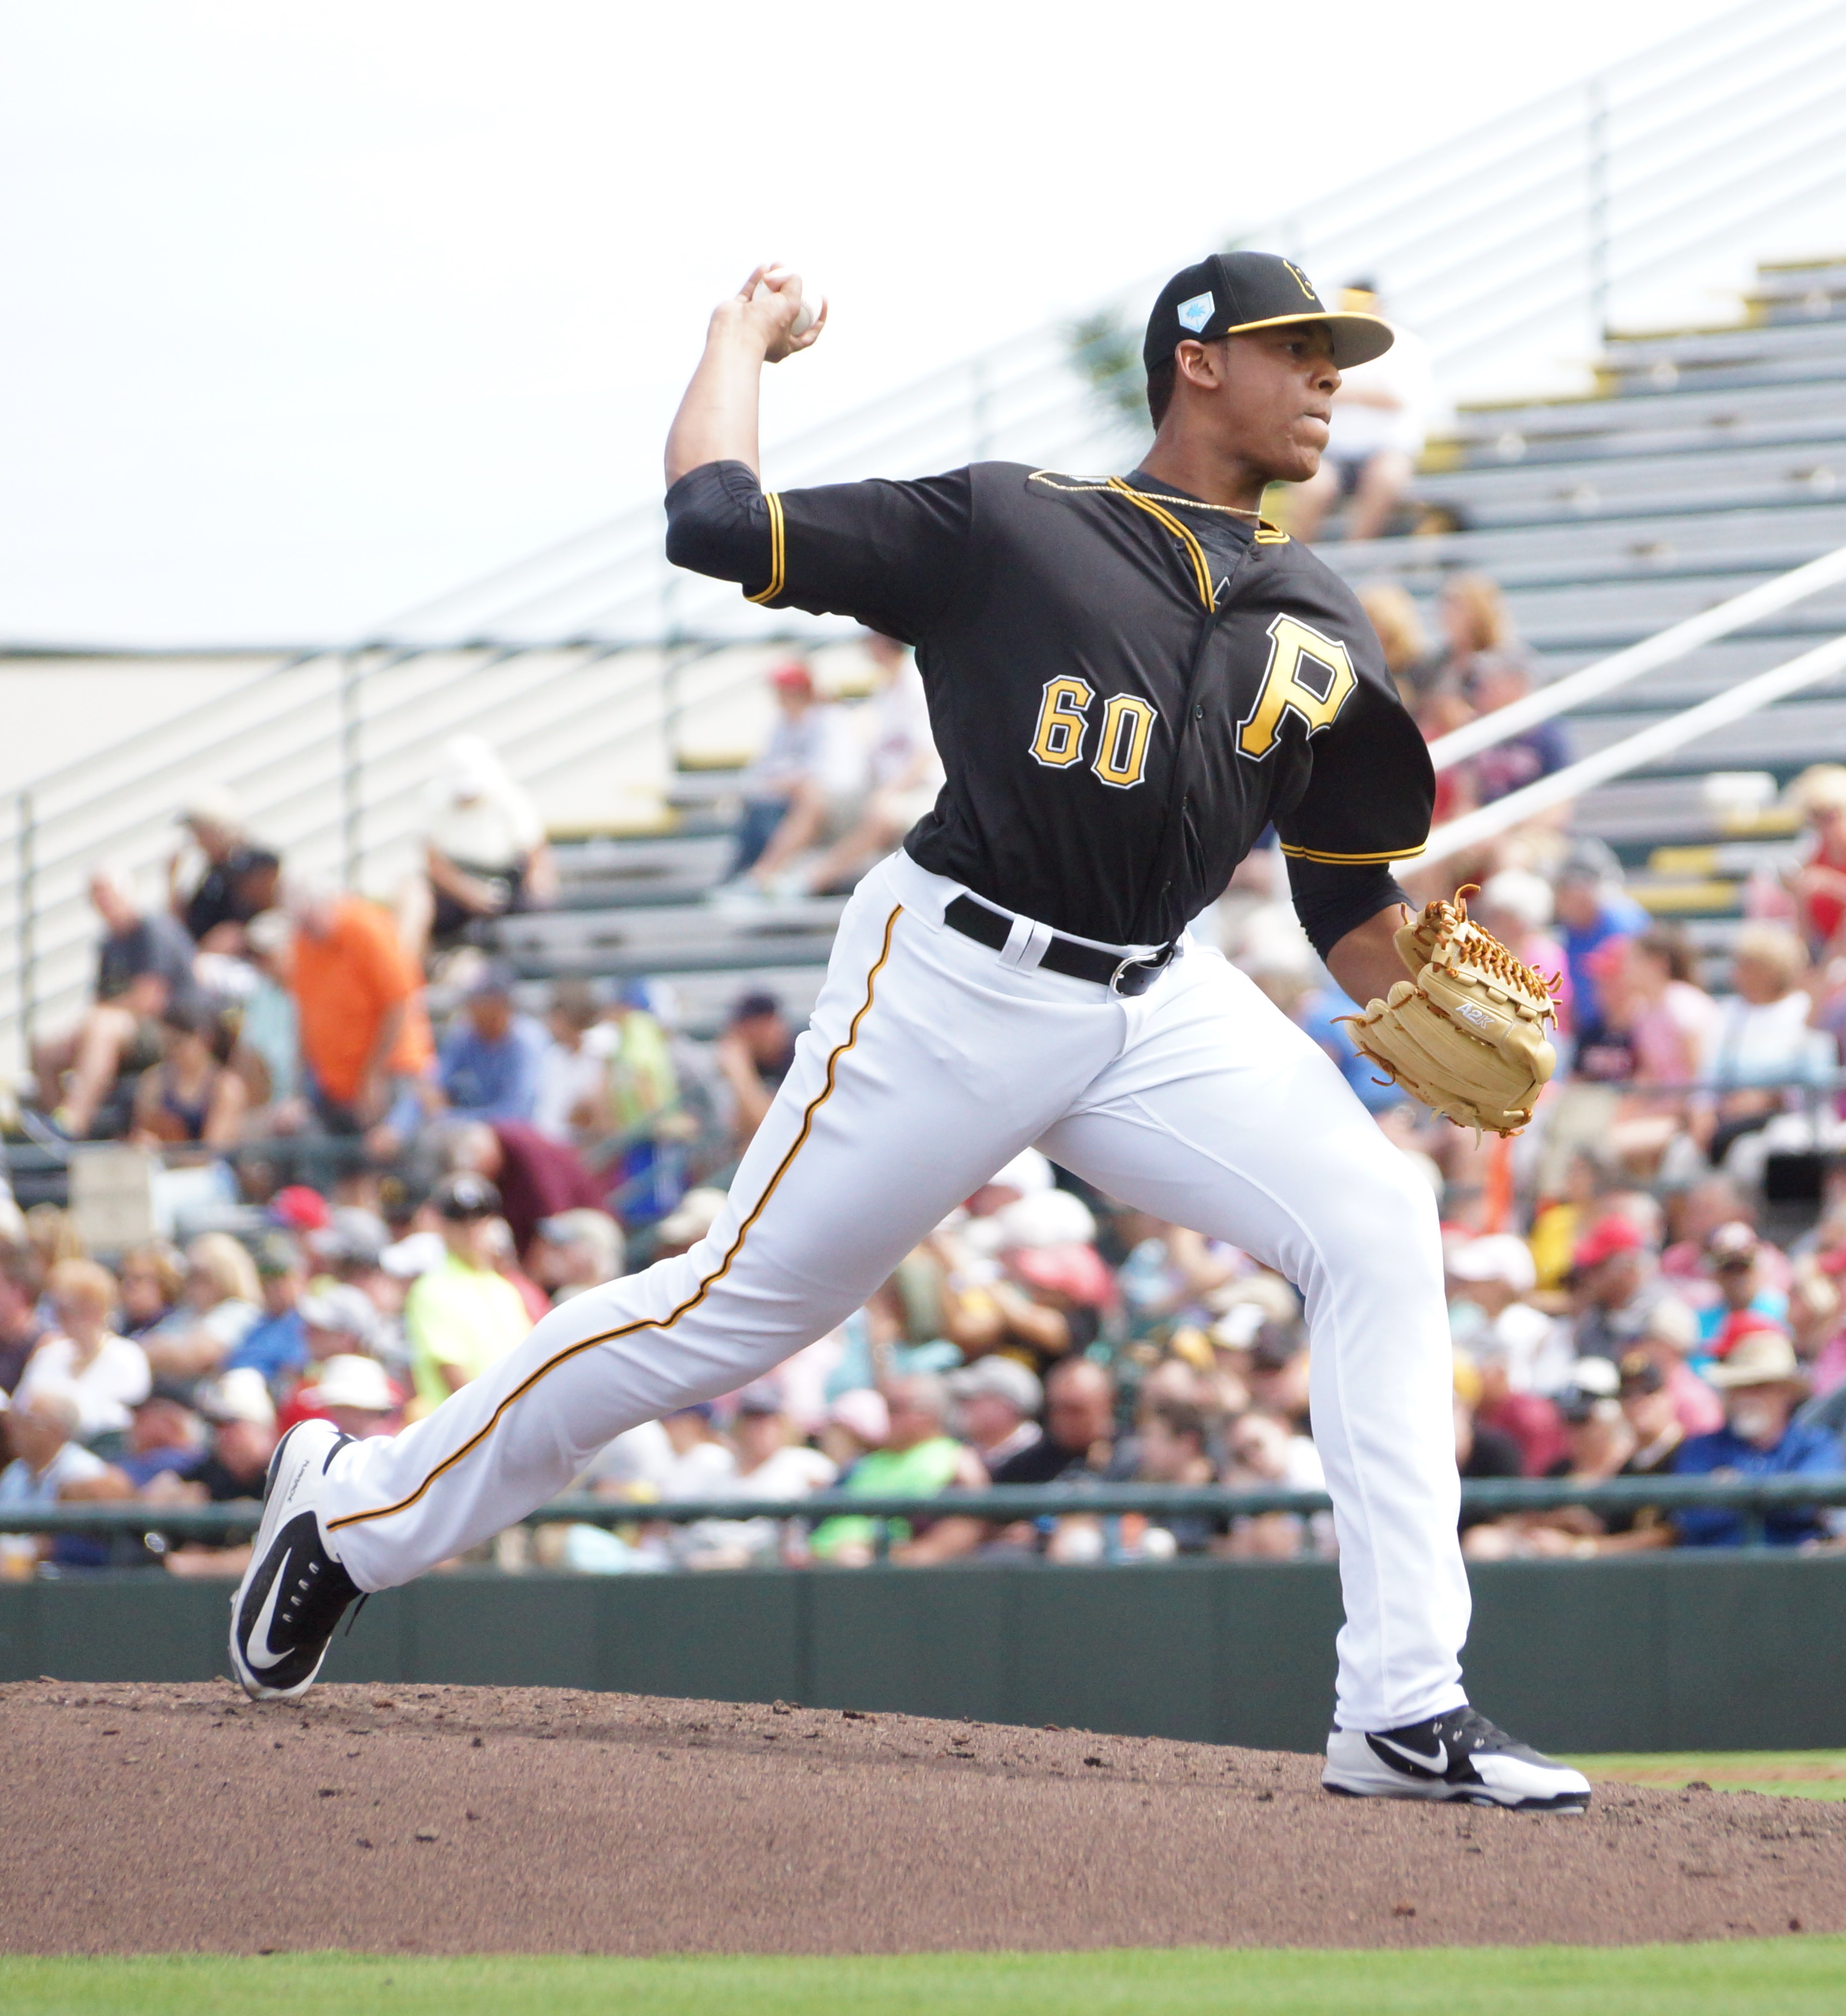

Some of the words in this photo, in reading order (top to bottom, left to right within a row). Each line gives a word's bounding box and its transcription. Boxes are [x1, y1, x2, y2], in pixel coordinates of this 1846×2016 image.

[1028, 674, 1158, 789] 60
[1236, 612, 1358, 762] P
[1455, 1003, 1495, 1029] A2K
